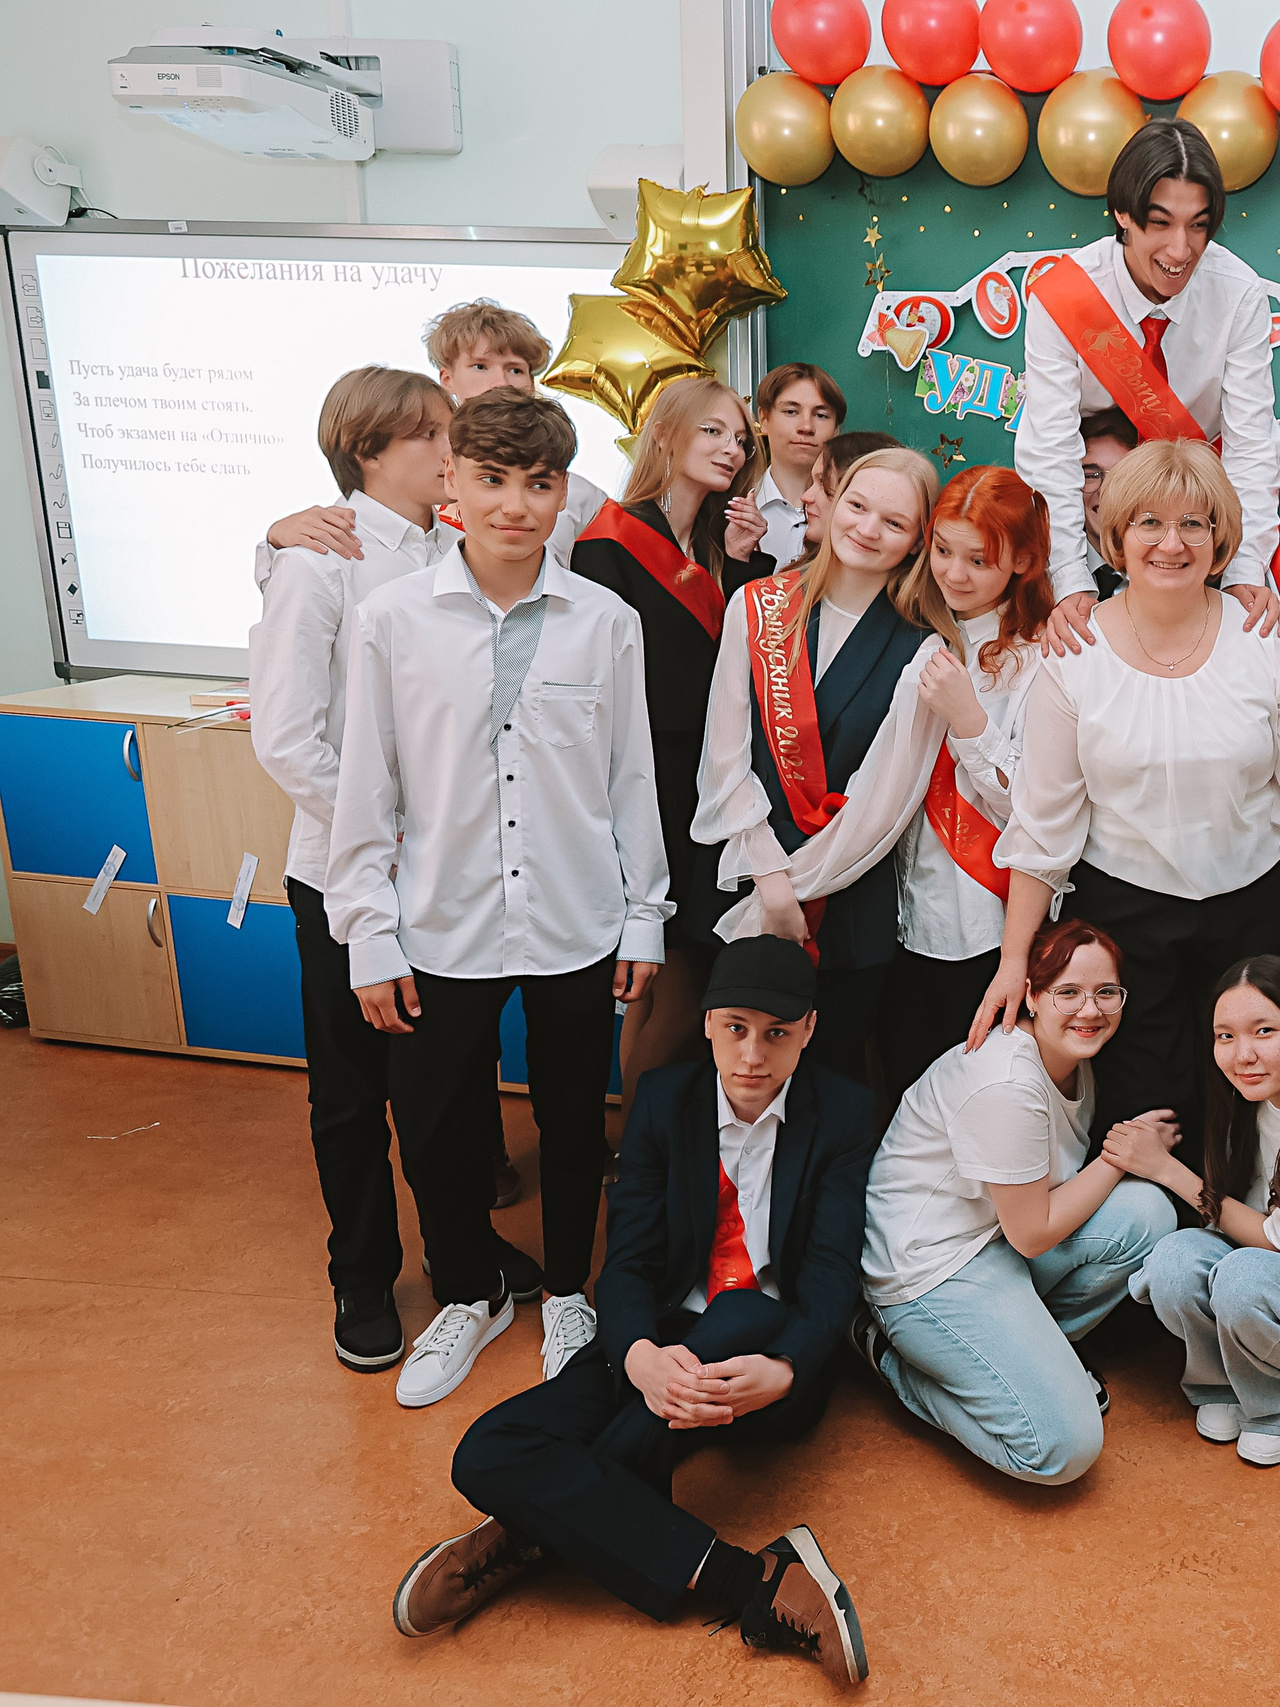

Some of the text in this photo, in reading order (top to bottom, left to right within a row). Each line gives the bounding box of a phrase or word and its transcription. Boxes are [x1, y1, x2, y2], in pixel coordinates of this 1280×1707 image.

[180, 257, 443, 291] Пожелания на удачу
[69, 359, 253, 383] Пусть удача будет рядом
[73, 391, 90, 407] За
[94, 395, 148, 409] плечом
[151, 397, 197, 411] твоим
[77, 422, 285, 445] Чтоб экзамен на «Отлично»
[81, 453, 251, 475] Получилось тебе сдать
